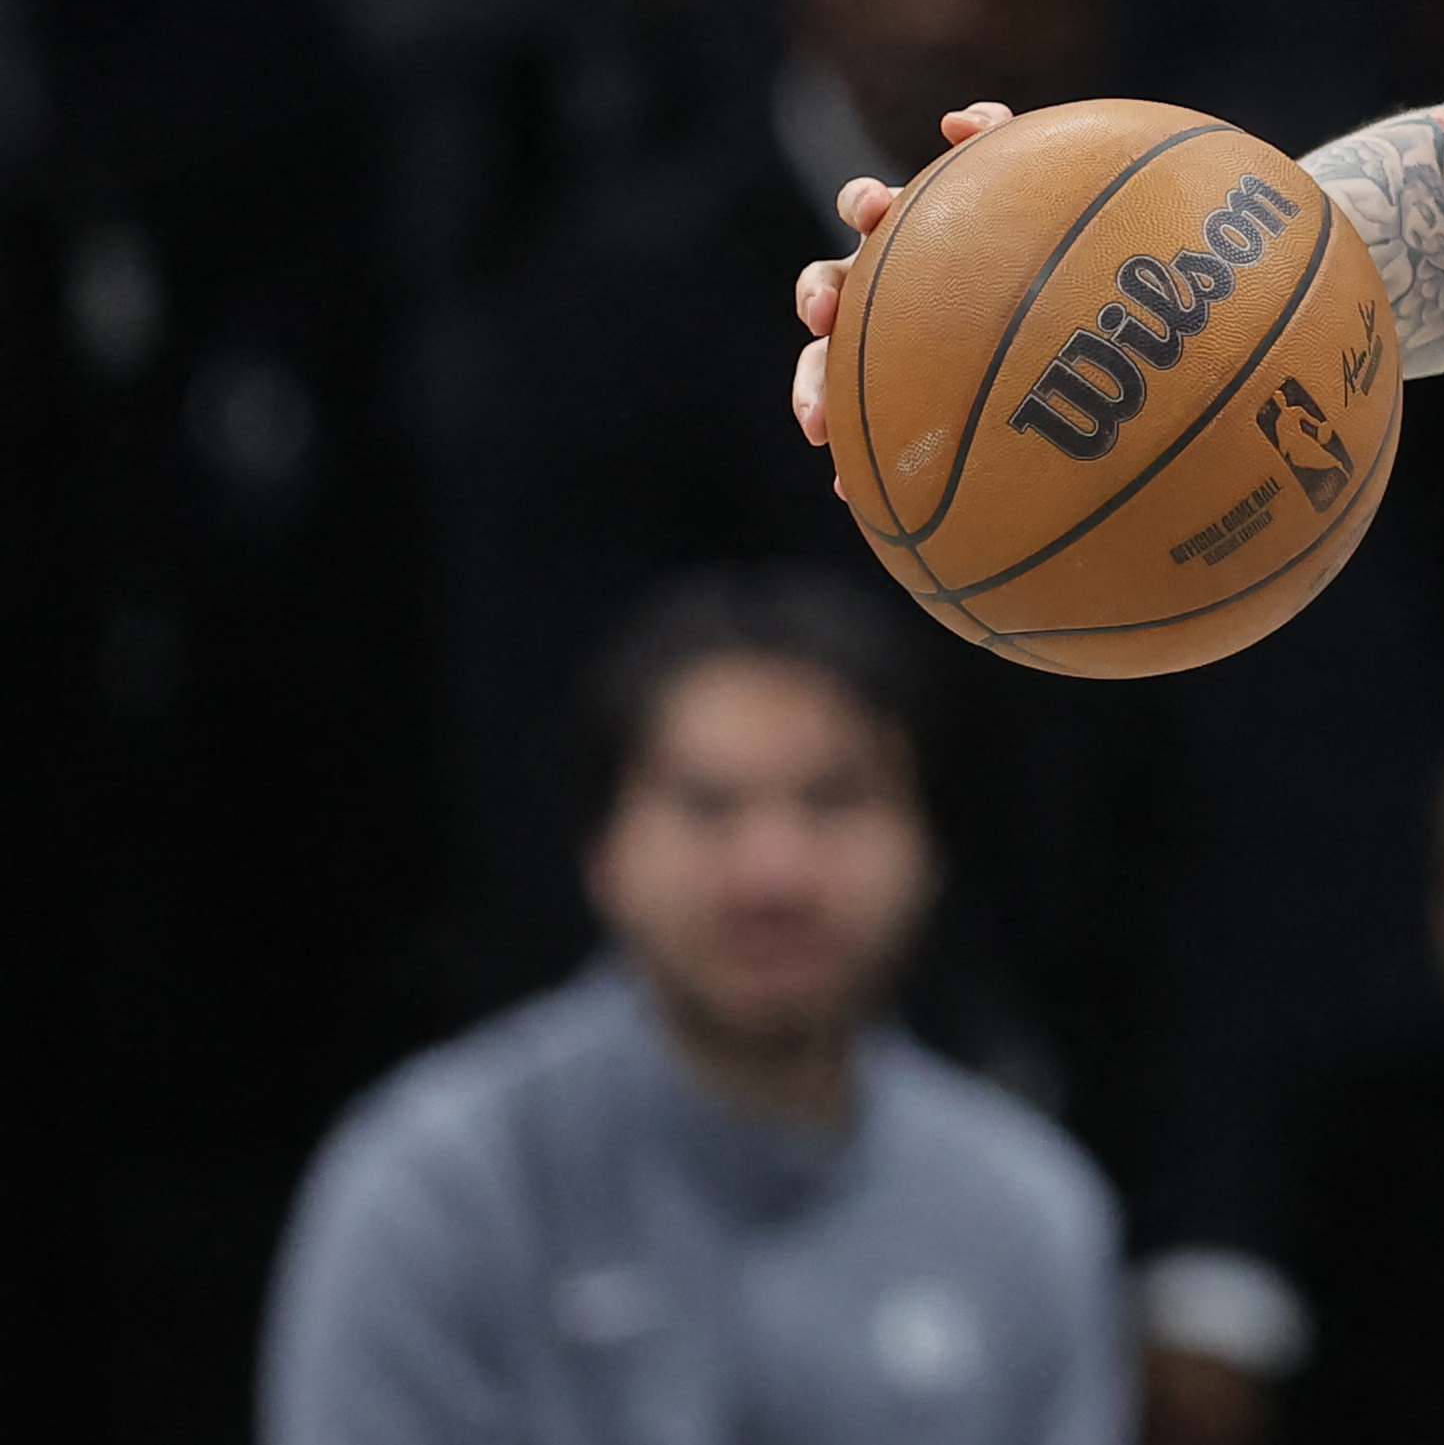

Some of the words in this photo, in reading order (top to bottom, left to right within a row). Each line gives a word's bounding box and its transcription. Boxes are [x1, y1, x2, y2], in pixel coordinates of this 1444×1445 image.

[1007, 174, 1301, 461] Wilson
[1170, 522, 1226, 565] OFFICIAL
[1221, 499, 1258, 533] GAME
[1251, 476, 1284, 508] BALL
